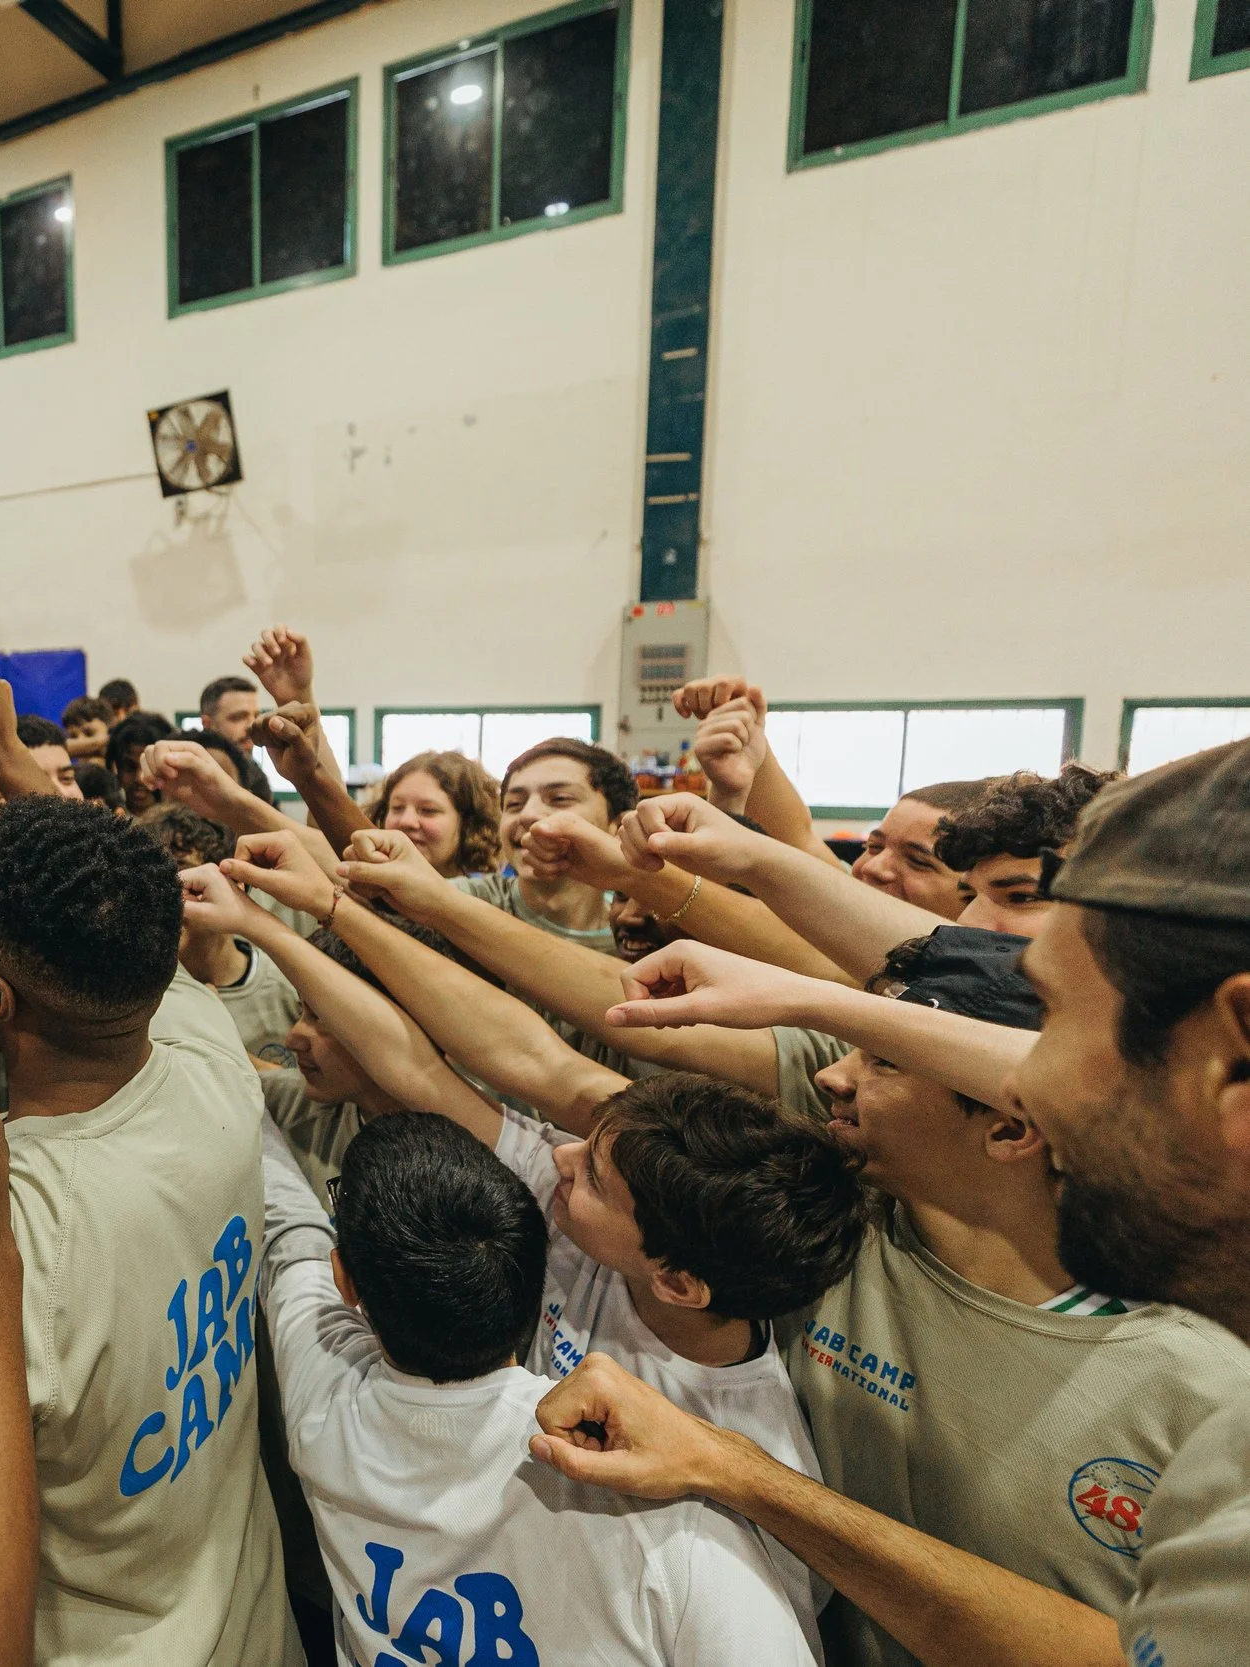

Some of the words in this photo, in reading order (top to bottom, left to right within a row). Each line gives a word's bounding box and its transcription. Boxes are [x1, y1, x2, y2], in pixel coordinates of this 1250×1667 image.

[166, 1215, 252, 1391] JAB
[120, 1264, 261, 1498] CAM
[801, 1336, 909, 1412] INTERNATIONAL
[1075, 1484, 1143, 1532] 48
[355, 1541, 540, 1667] JAB
